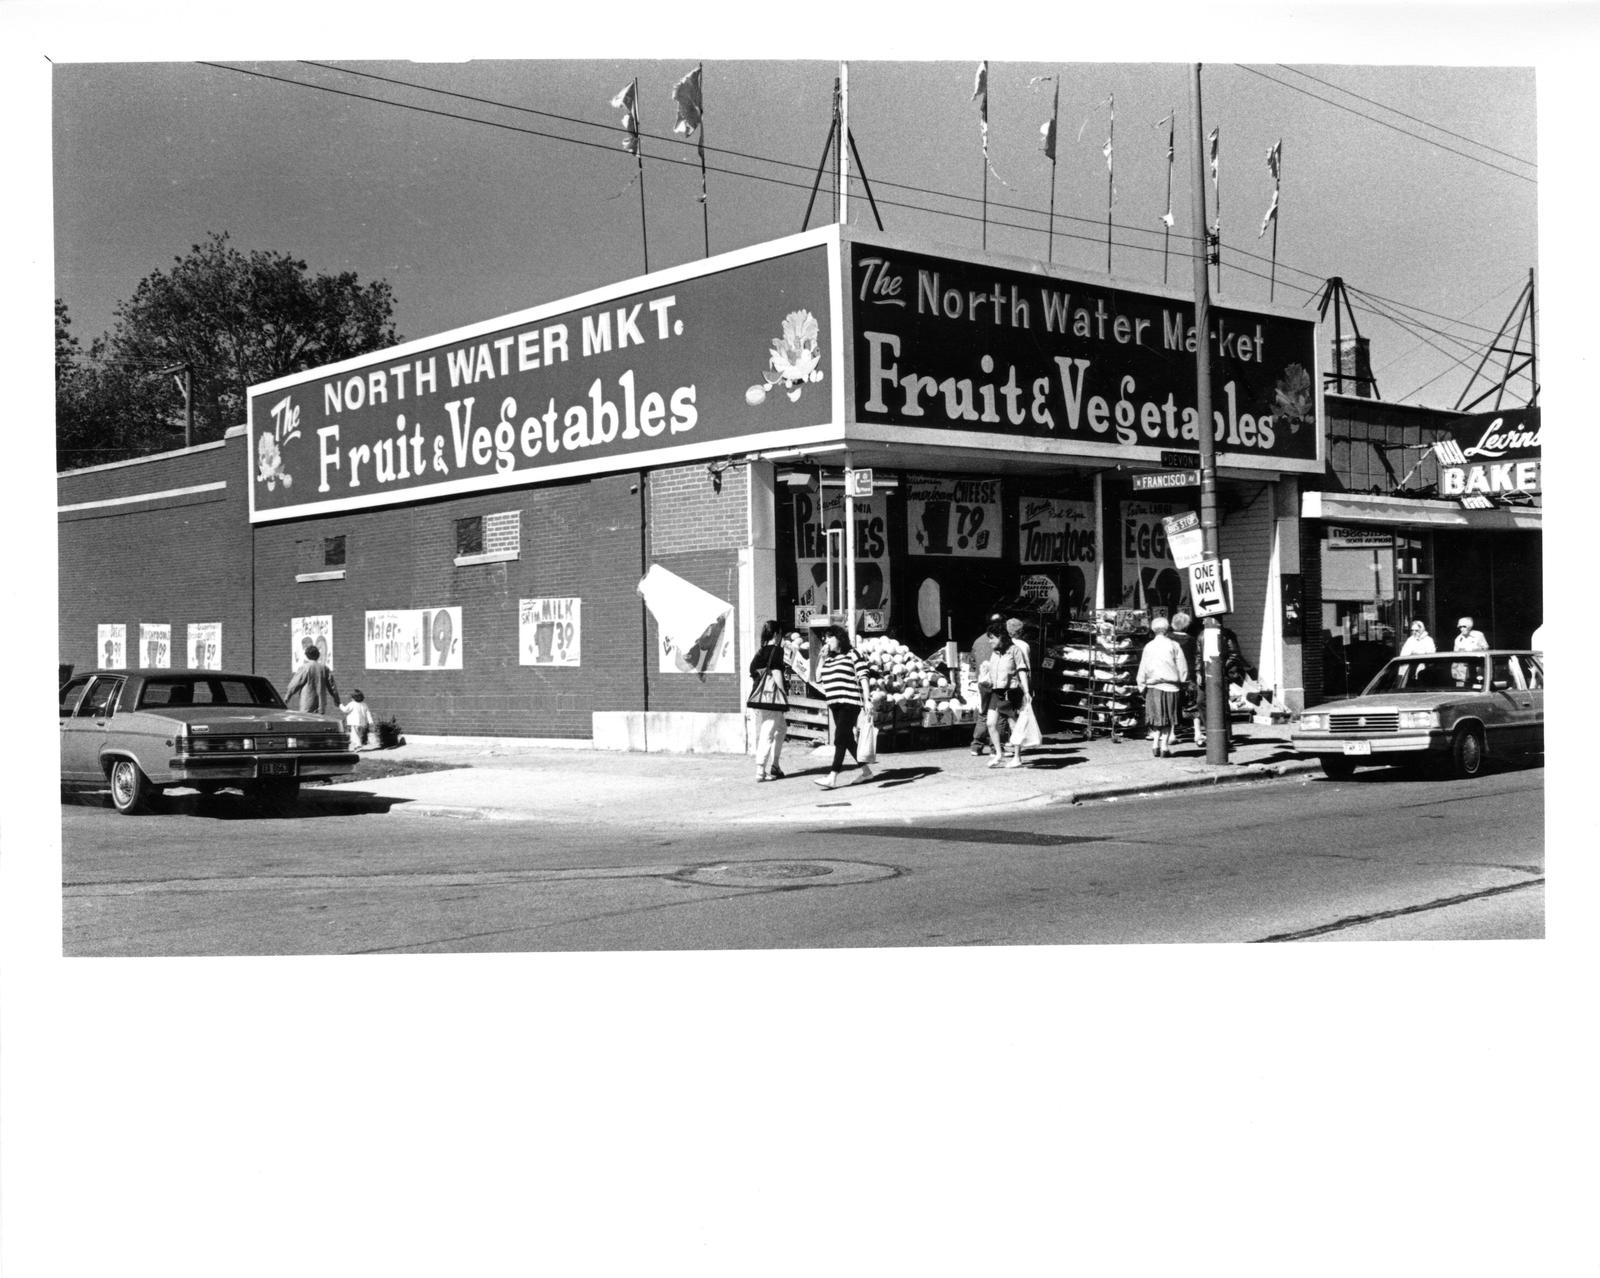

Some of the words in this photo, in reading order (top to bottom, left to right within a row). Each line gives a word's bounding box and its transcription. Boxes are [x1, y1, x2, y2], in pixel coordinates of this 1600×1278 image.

[858, 257, 903, 305] The
[917, 269, 1030, 329] North
[1041, 288, 1151, 345] Water
[1163, 308, 1264, 364] Maket
[270, 395, 301, 443] The
[324, 357, 437, 415] NORTH
[447, 323, 569, 387] WATER
[582, 295, 685, 357] MKT.
[864, 330, 1026, 426] Fruit
[1031, 376, 1055, 430] &
[317, 414, 426, 493] Fruit
[433, 436, 449, 475] &
[445, 369, 699, 474] Vegetables
[954, 480, 996, 503] CHEESE
[1142, 473, 1186, 488] FRANCISCO
[1444, 461, 1541, 496] BAKE
[1021, 519, 1096, 562] Tomatoes
[1194, 564, 1214, 580] ONE
[1196, 580, 1216, 596] WAY
[542, 599, 574, 620] MILK
